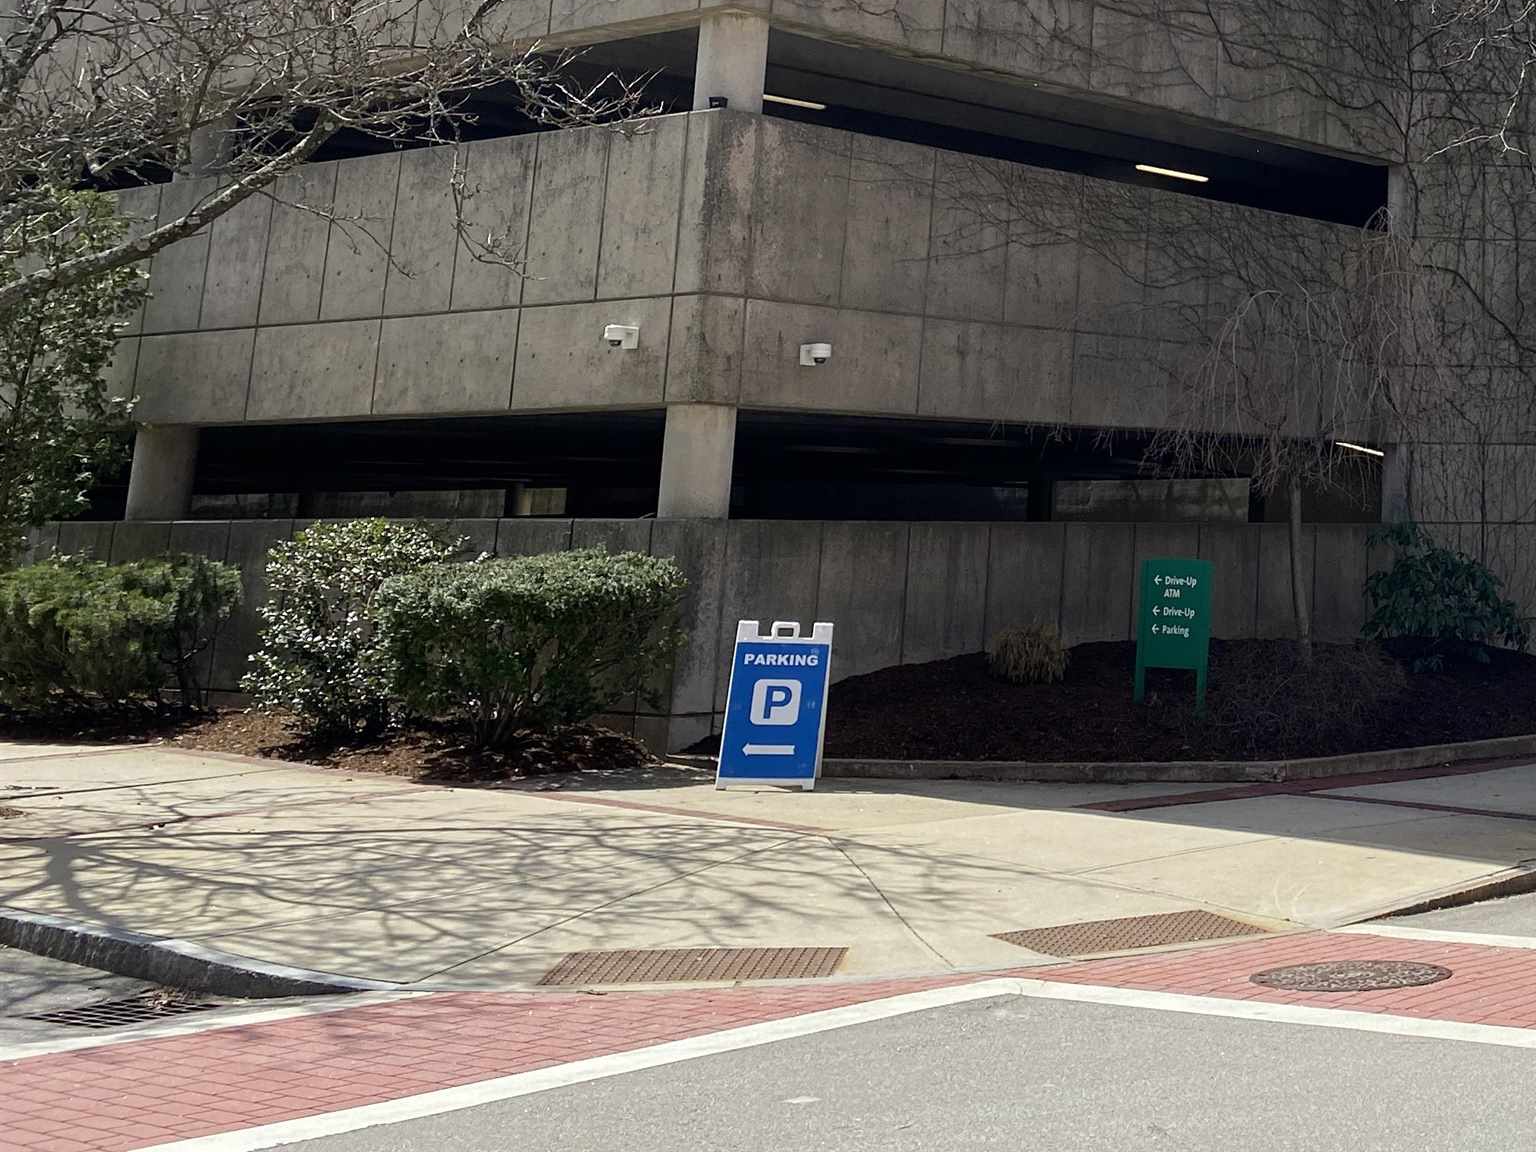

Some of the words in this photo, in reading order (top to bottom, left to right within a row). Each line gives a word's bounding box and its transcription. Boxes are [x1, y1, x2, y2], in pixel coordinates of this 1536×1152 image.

[1164, 575, 1197, 588] Drive-Up
[1163, 588, 1181, 598] ATM
[1163, 606, 1196, 619] Drive-Up
[1162, 624, 1190, 638] Parking
[743, 653, 819, 666] PARKING
[763, 685, 793, 720] P
